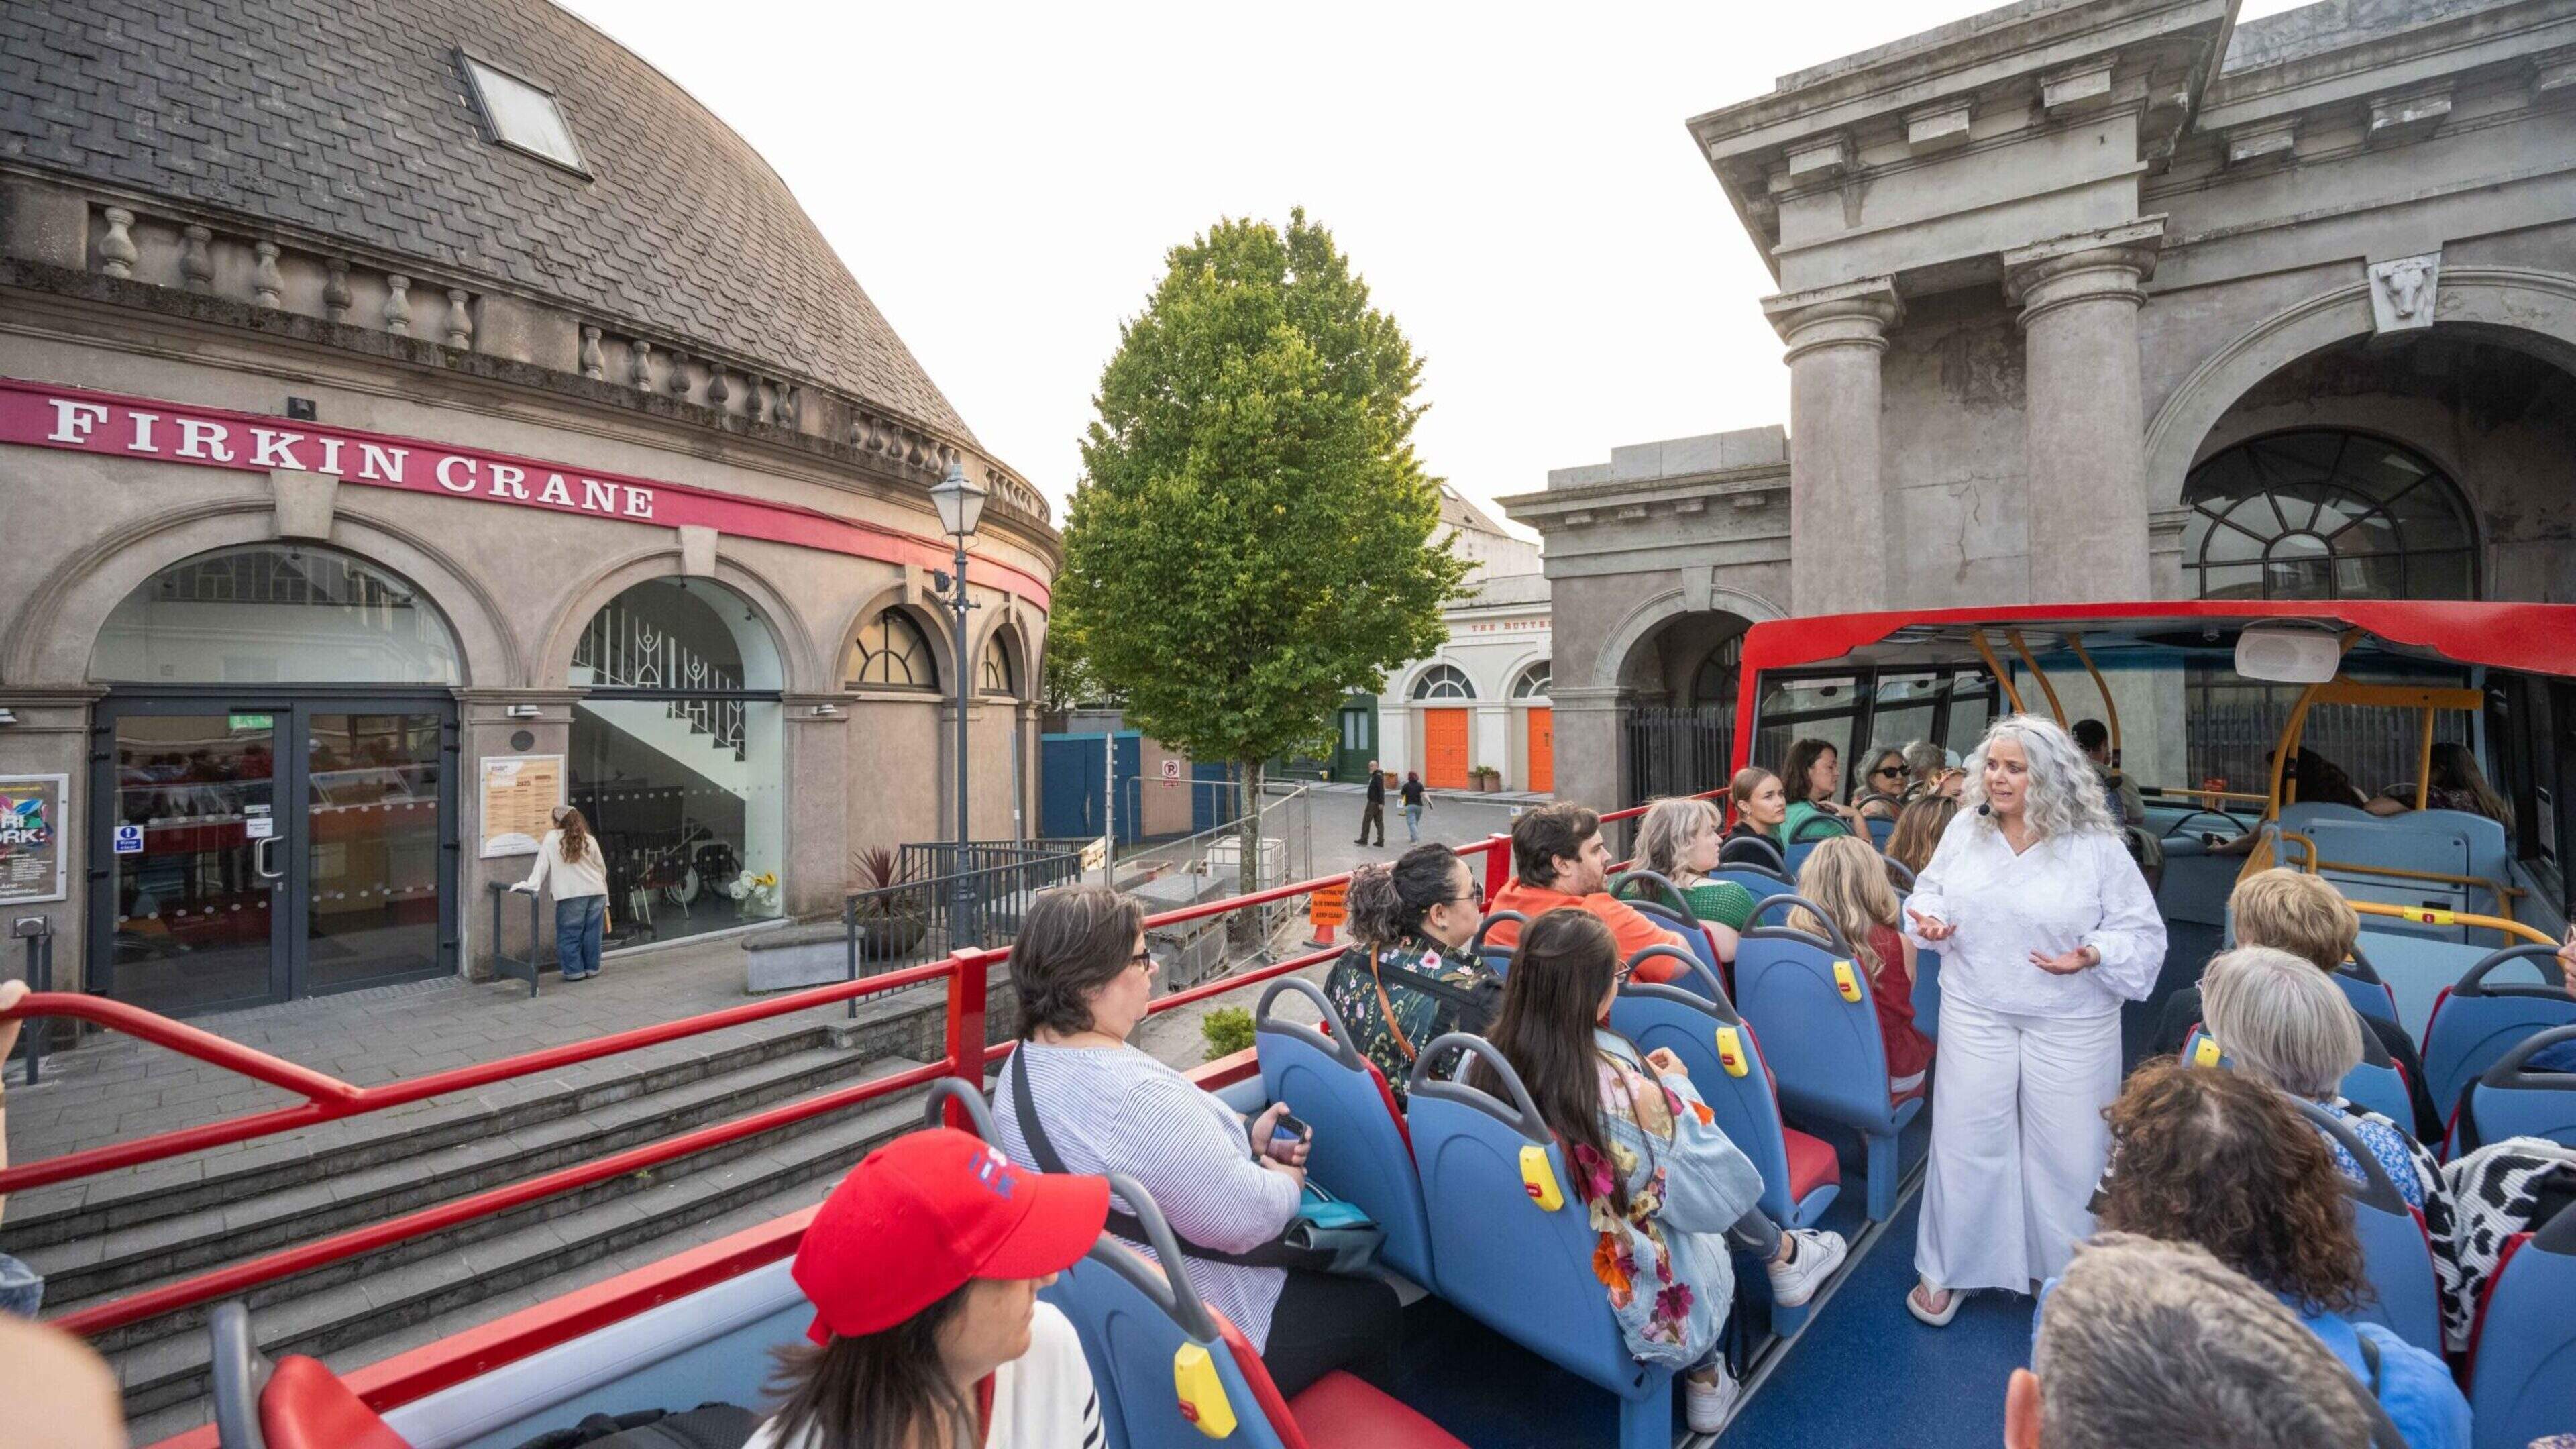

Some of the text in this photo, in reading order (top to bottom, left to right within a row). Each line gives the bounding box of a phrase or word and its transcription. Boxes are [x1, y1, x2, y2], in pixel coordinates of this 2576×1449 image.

[48, 398, 653, 519] FIRKIN CRANE
[1472, 623, 1495, 631] THE
[0, 828, 45, 844] RK:
